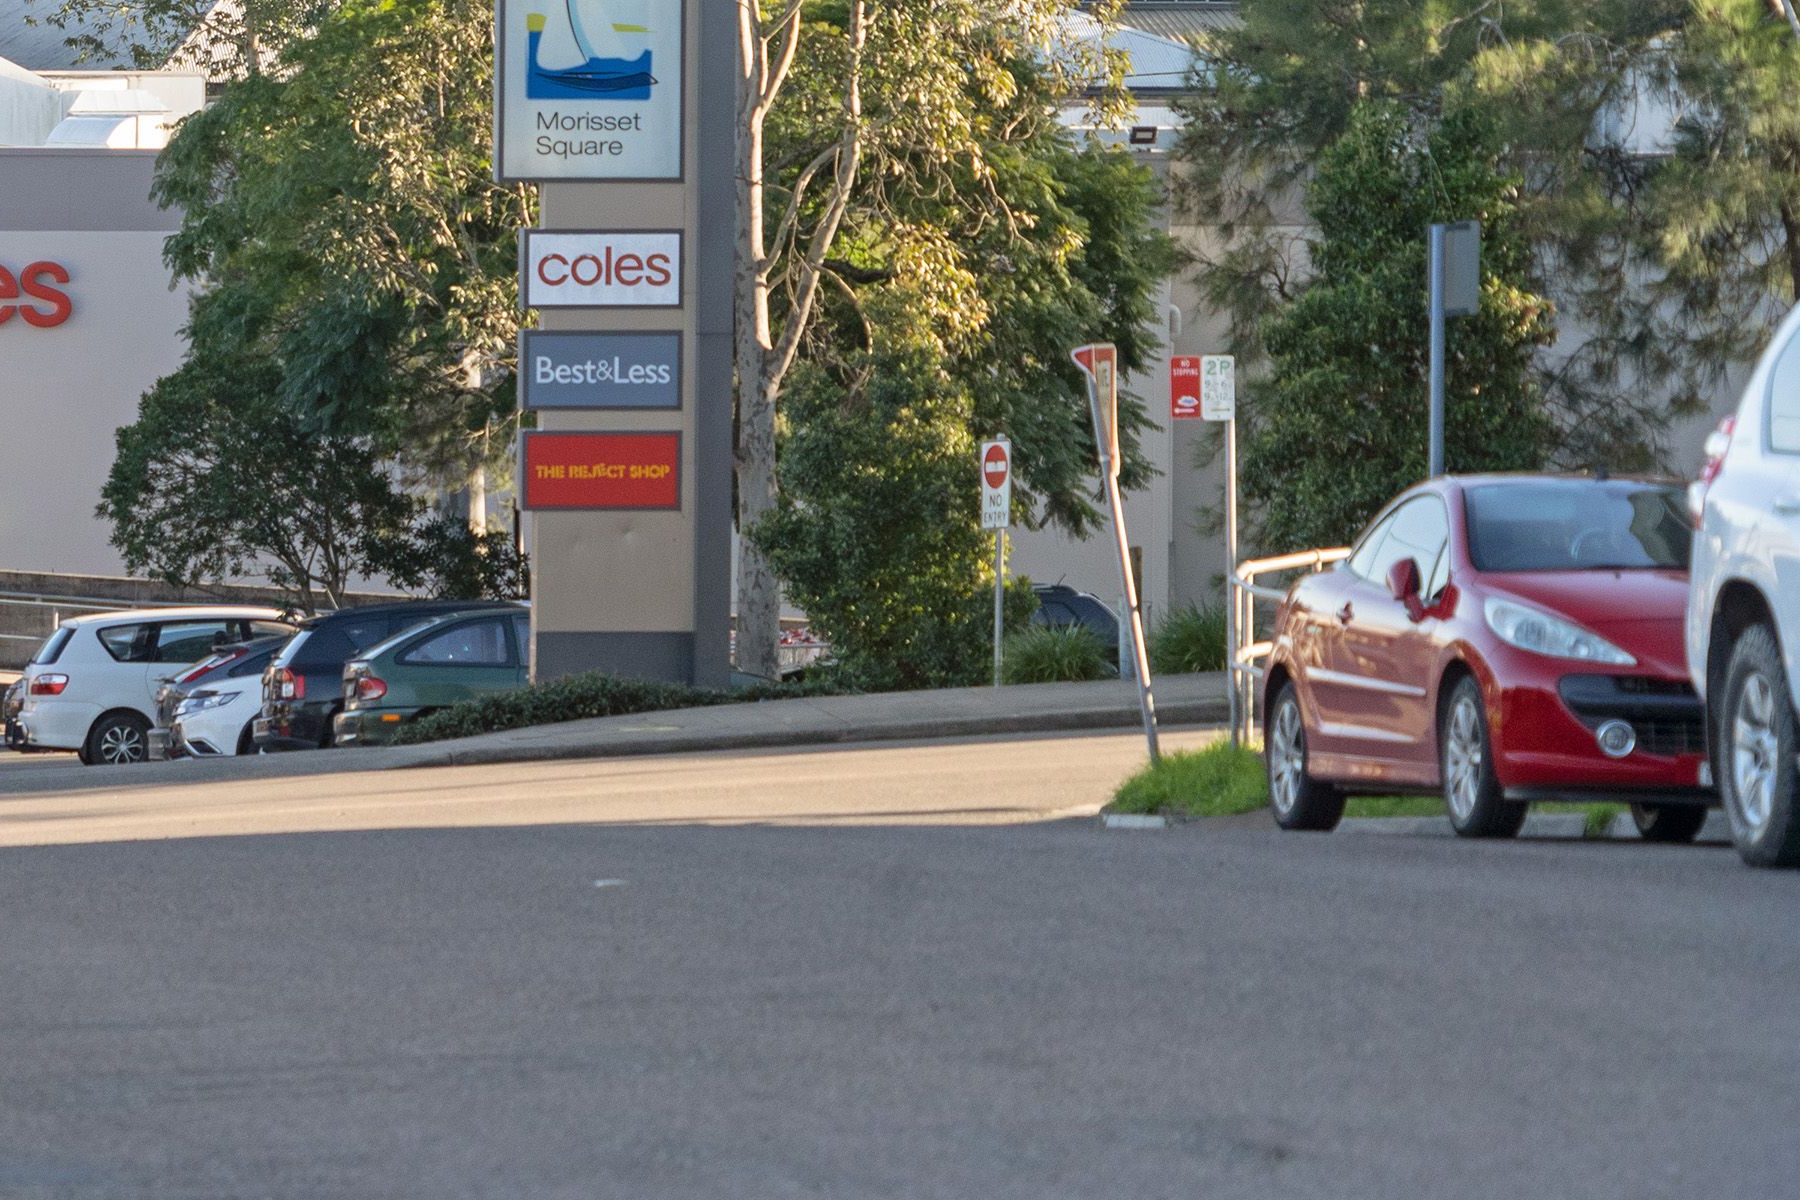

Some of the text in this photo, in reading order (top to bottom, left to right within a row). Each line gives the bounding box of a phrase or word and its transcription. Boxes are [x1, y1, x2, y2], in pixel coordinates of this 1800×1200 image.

[536, 111, 642, 131] Morisset
[536, 135, 623, 160] Square
[537, 246, 672, 287] coles
[535, 356, 671, 385] Best&Less
[1180, 359, 1191, 368] NO
[1207, 360, 1231, 375] 2P
[1173, 368, 1199, 377] STOPPING
[535, 462, 670, 479] THE REJECT SHOP
[989, 494, 1003, 507] NO
[983, 511, 1007, 523] ENTRY
